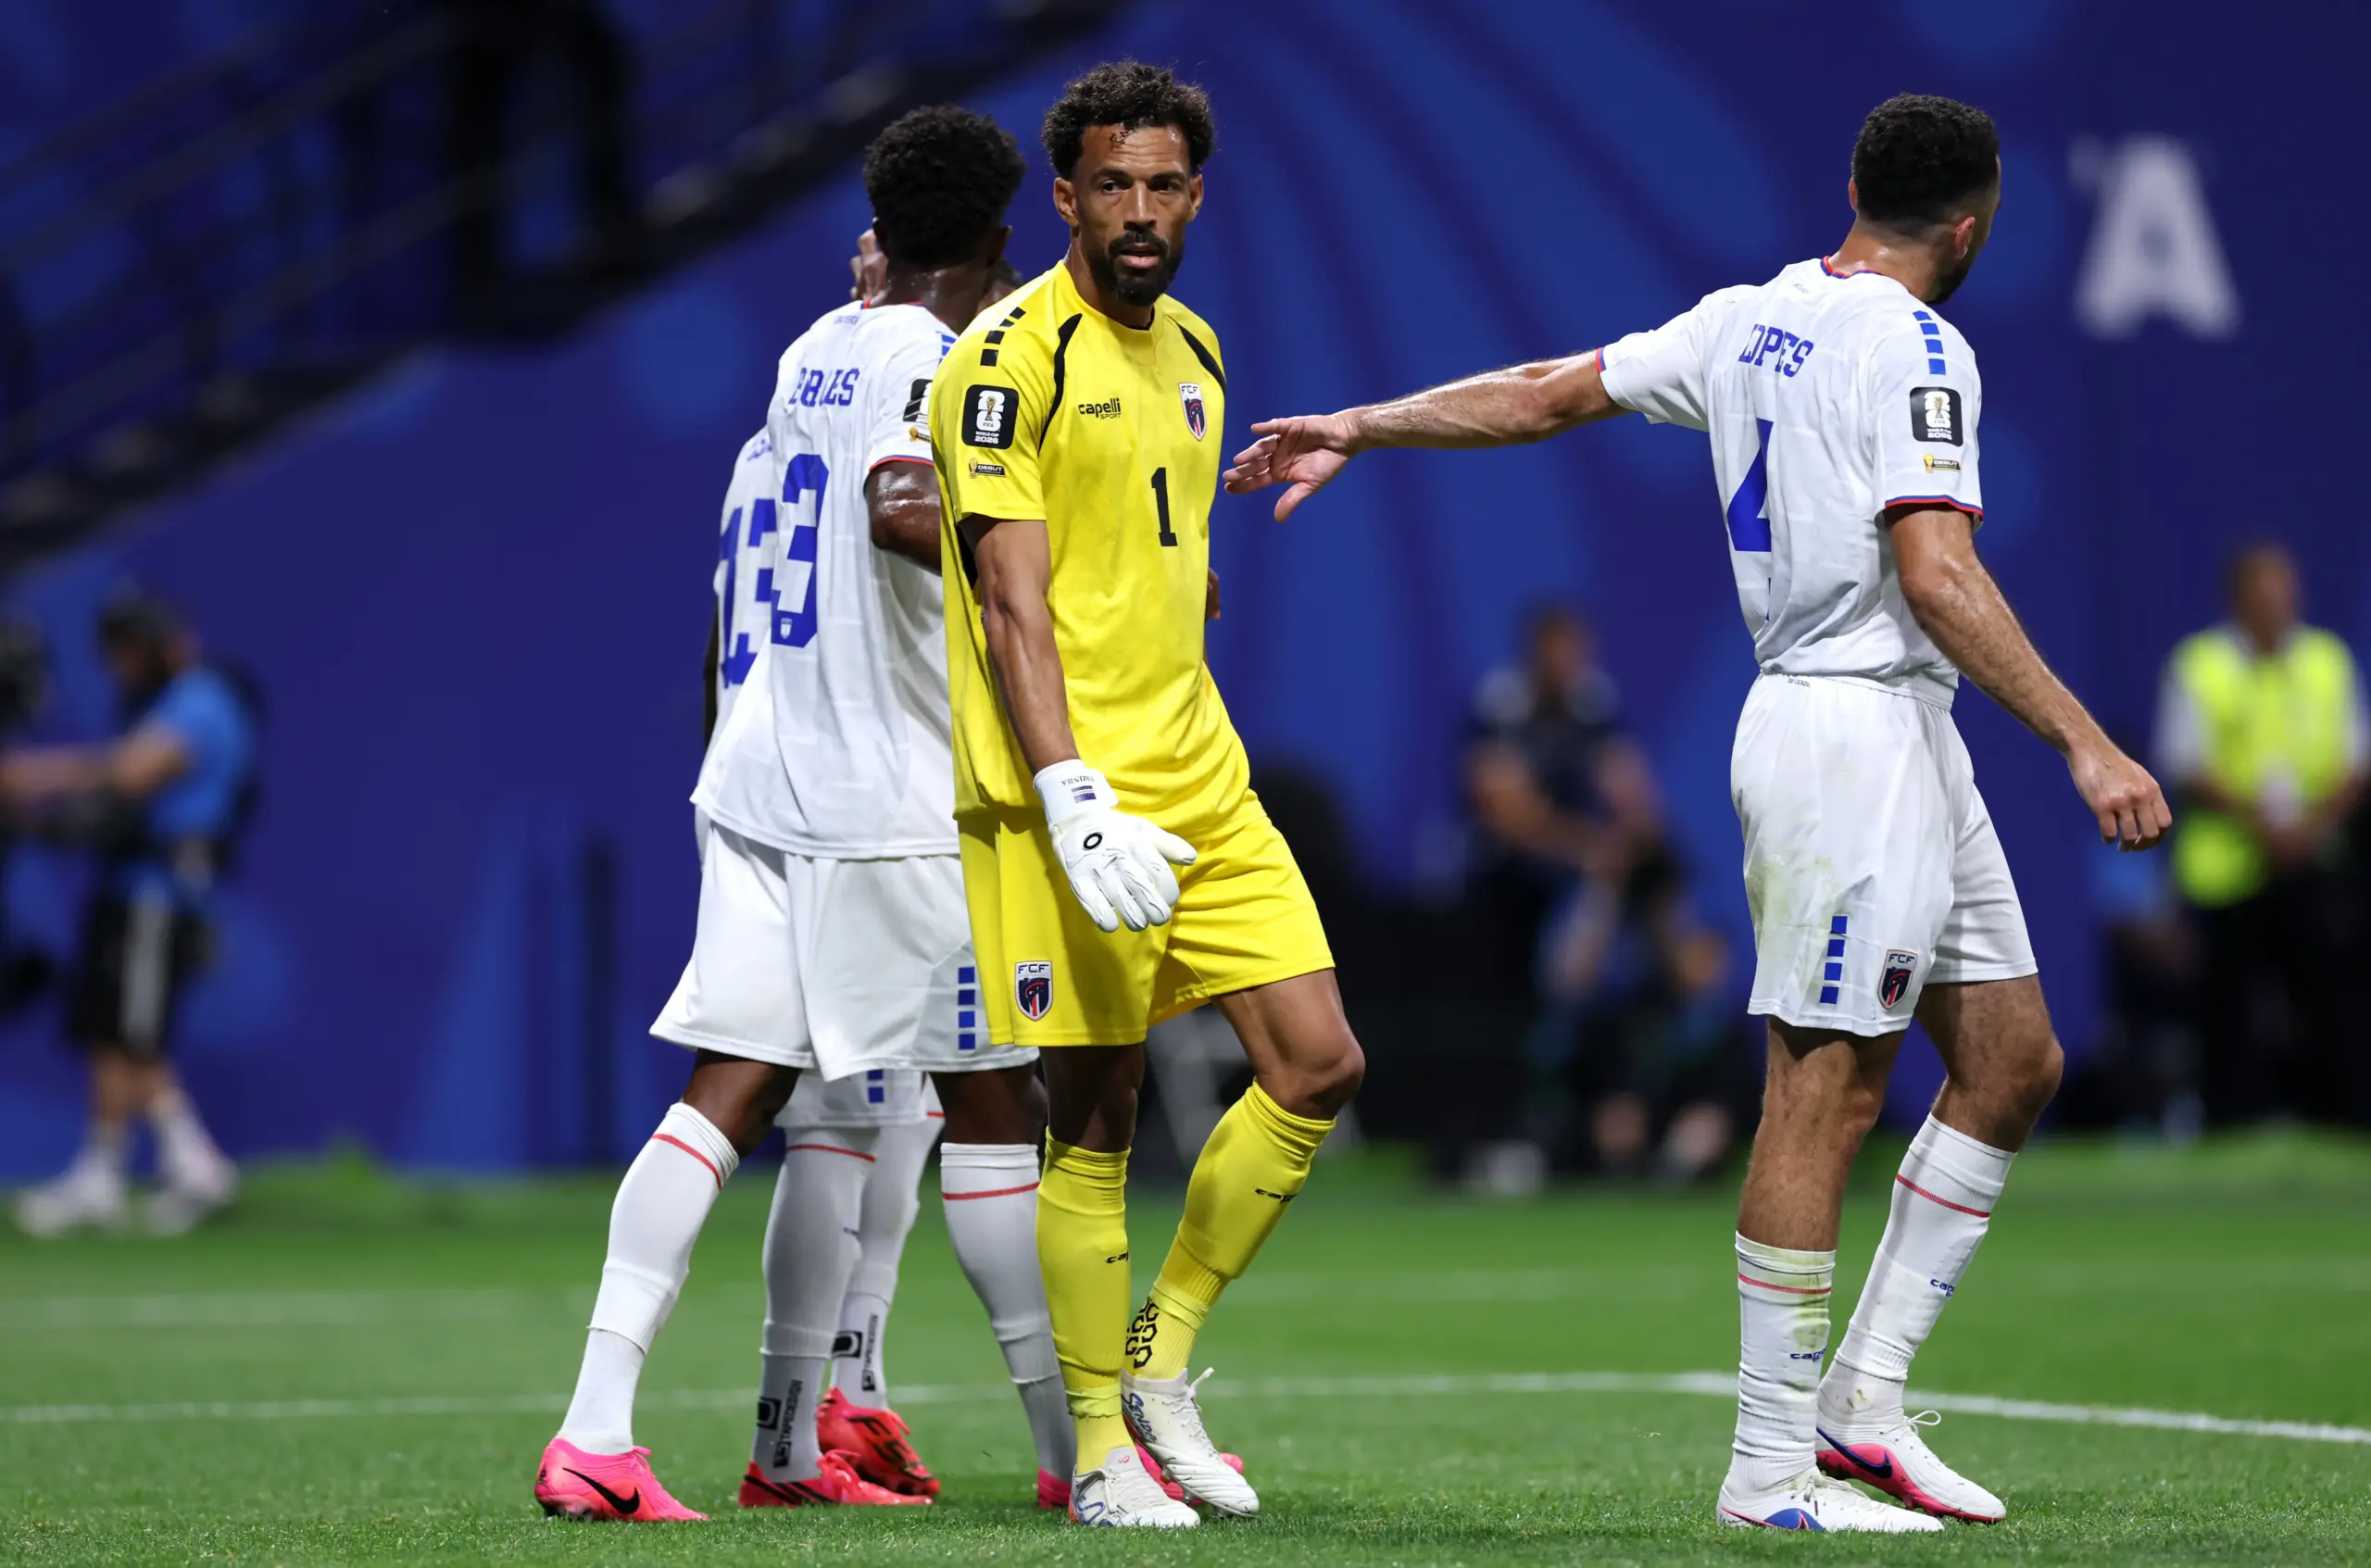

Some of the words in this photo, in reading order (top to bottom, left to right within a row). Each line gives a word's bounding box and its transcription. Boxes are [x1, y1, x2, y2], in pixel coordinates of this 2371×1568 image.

[1181, 384, 1198, 395] FCF
[1078, 397, 1122, 418] capelli
[974, 436, 999, 445] 2026
[1150, 467, 1178, 546] 1
[771, 453, 830, 648] 3
[1888, 953, 1915, 964] FCF
[1018, 963, 1049, 973] FCF
